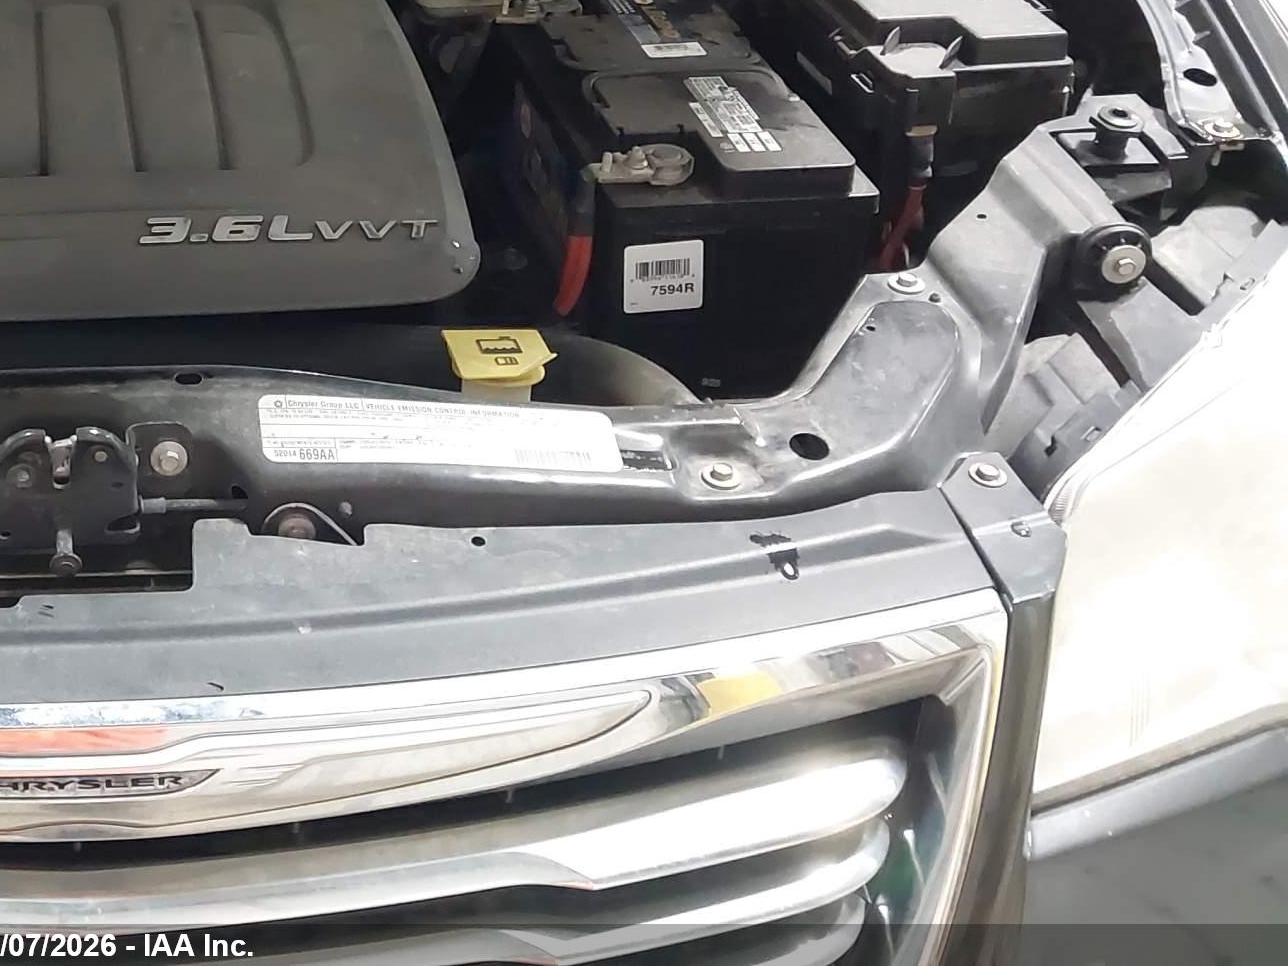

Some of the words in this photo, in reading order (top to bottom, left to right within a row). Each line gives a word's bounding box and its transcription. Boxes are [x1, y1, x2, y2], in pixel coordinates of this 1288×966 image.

[651, 283, 695, 296] 7594R
[287, 400, 318, 409] Chrysler
[345, 402, 360, 410] LLC
[299, 448, 336, 461] 669AA
